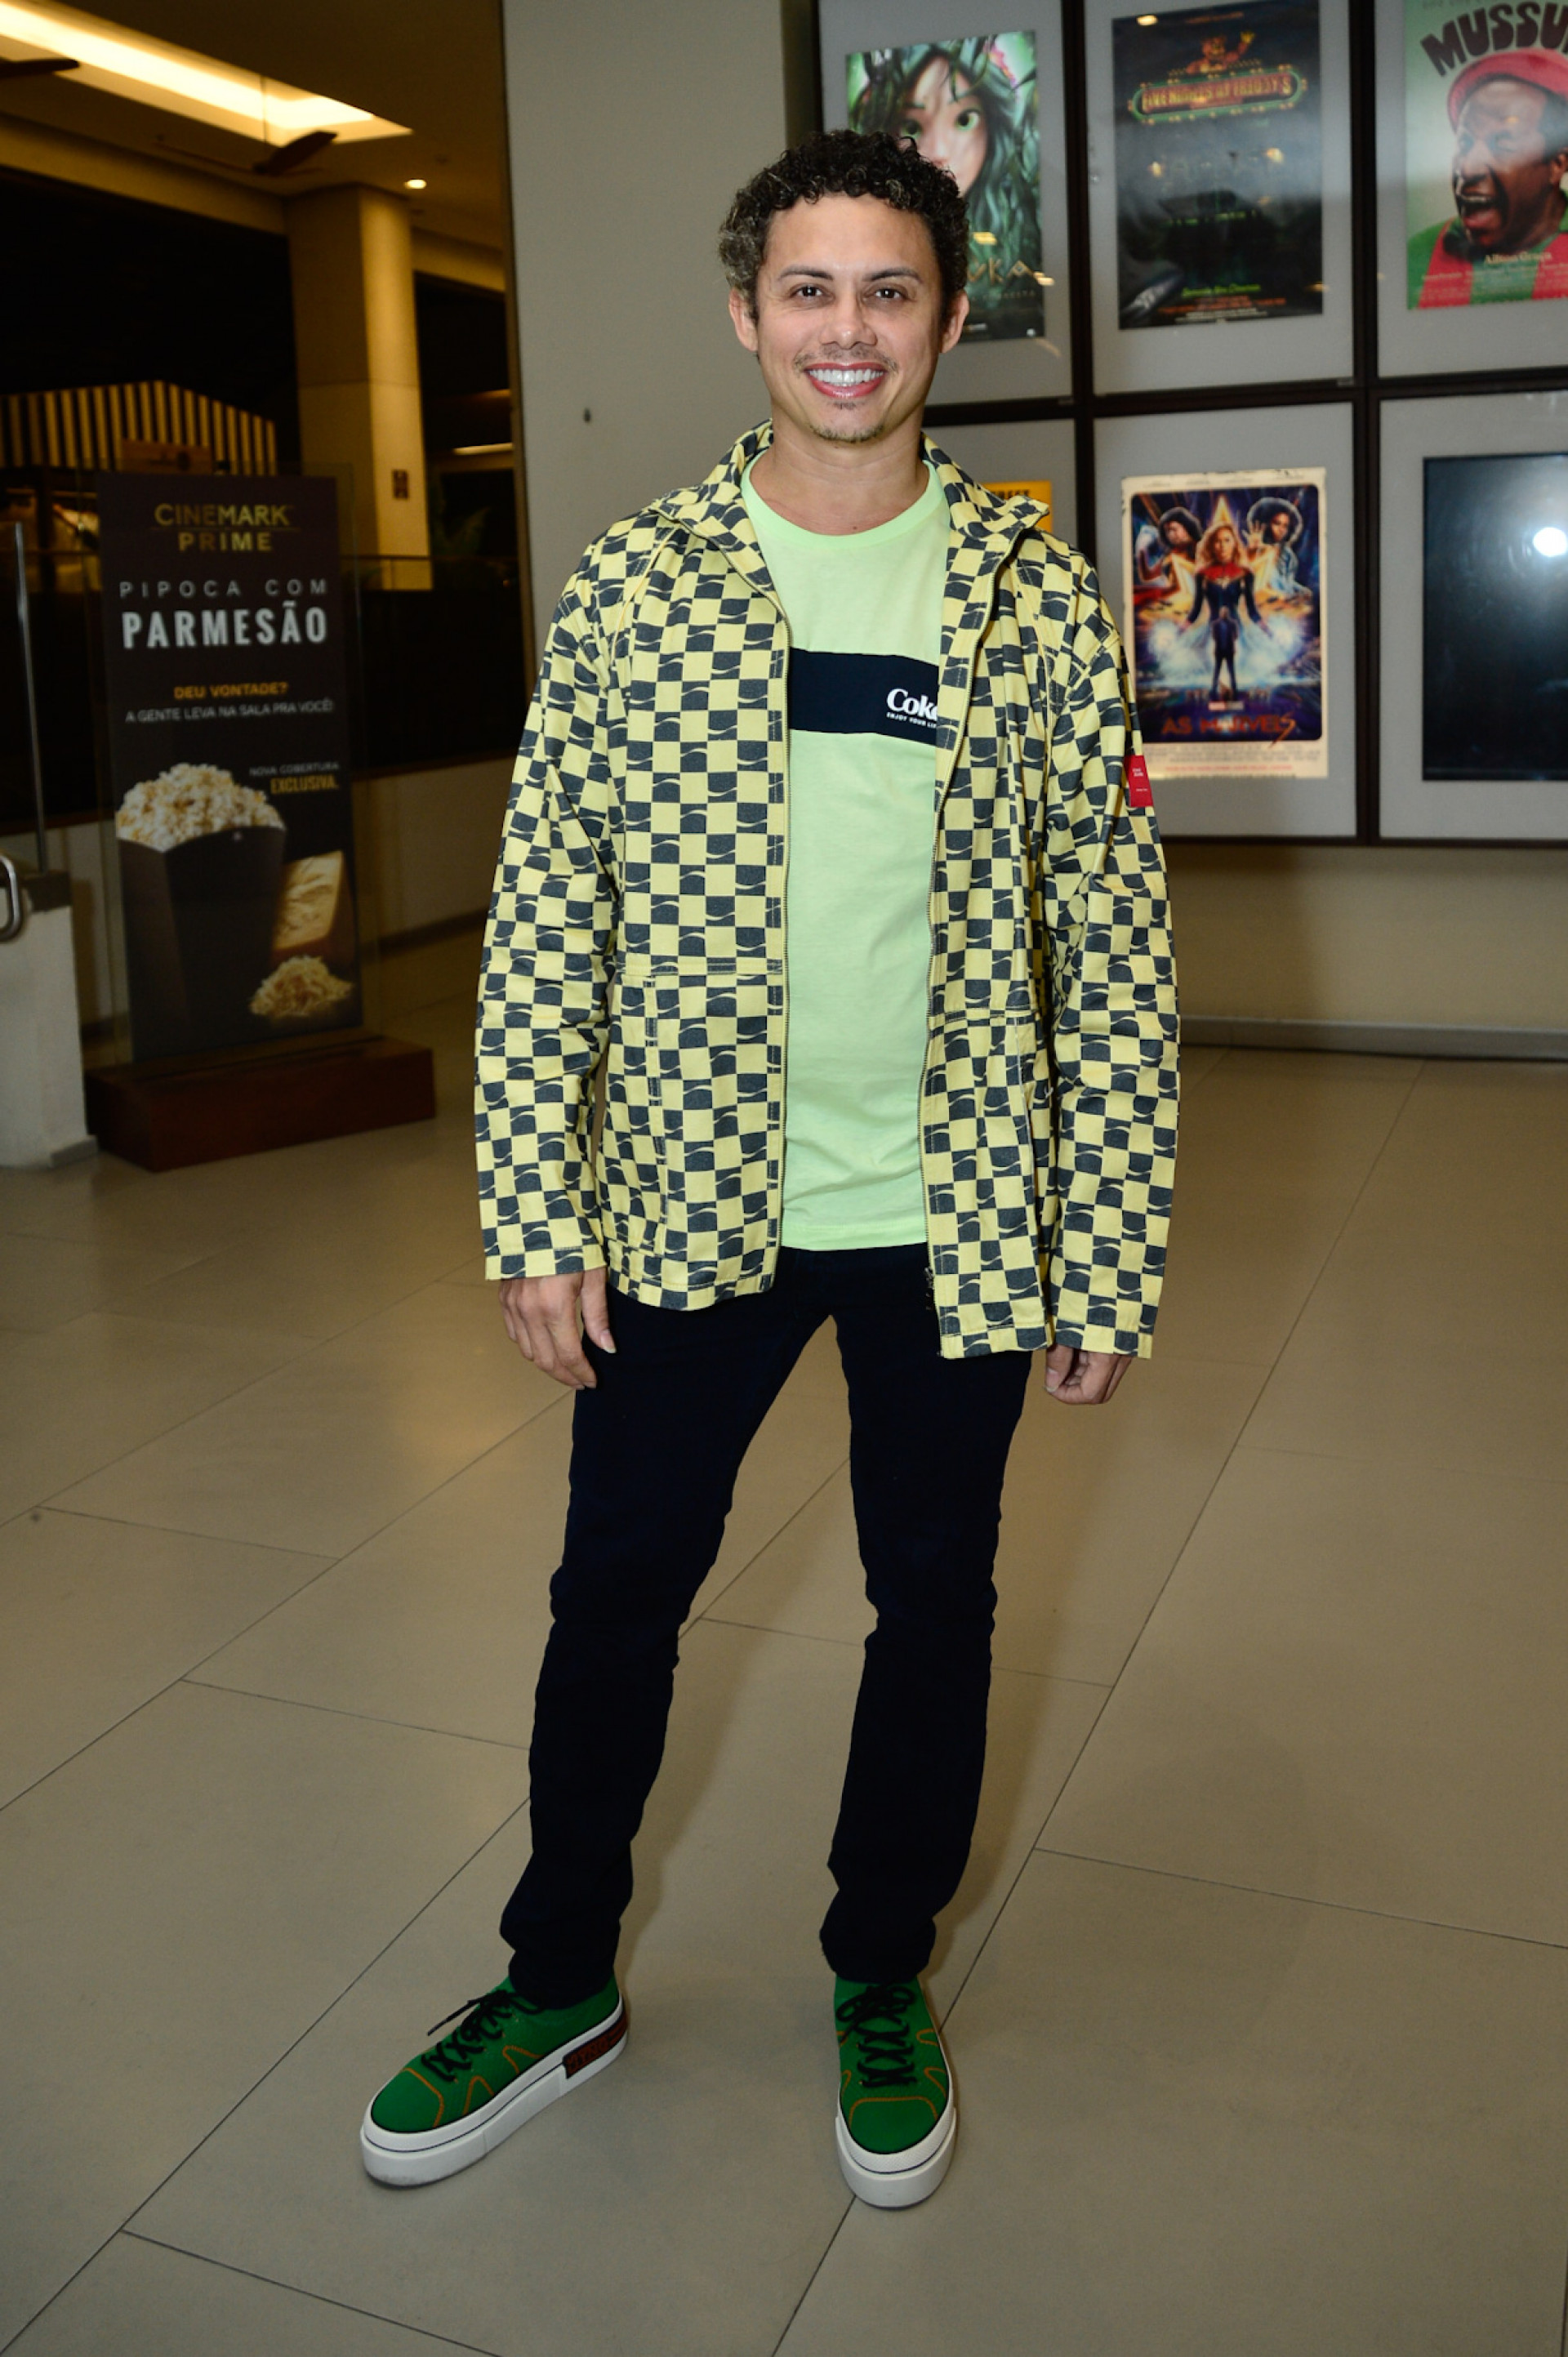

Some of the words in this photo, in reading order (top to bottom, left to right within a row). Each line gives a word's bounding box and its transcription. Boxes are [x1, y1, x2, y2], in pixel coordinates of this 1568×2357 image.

[1419, 2, 1568, 77] MUSSU
[154, 504, 290, 526] CINEMARK
[178, 532, 273, 552] PRIME
[120, 579, 241, 598] PIPOCA
[265, 578, 326, 596] COM
[122, 600, 327, 649] PARMESÃO
[174, 686, 206, 700] DEU
[209, 681, 289, 698] VONTADE?
[125, 710, 136, 723] A
[137, 707, 180, 722] GENTE
[184, 706, 216, 720] LEVA
[218, 704, 238, 717] NA
[239, 702, 270, 715] SALA
[272, 701, 296, 714] PRA
[1160, 715, 1193, 734] AS
